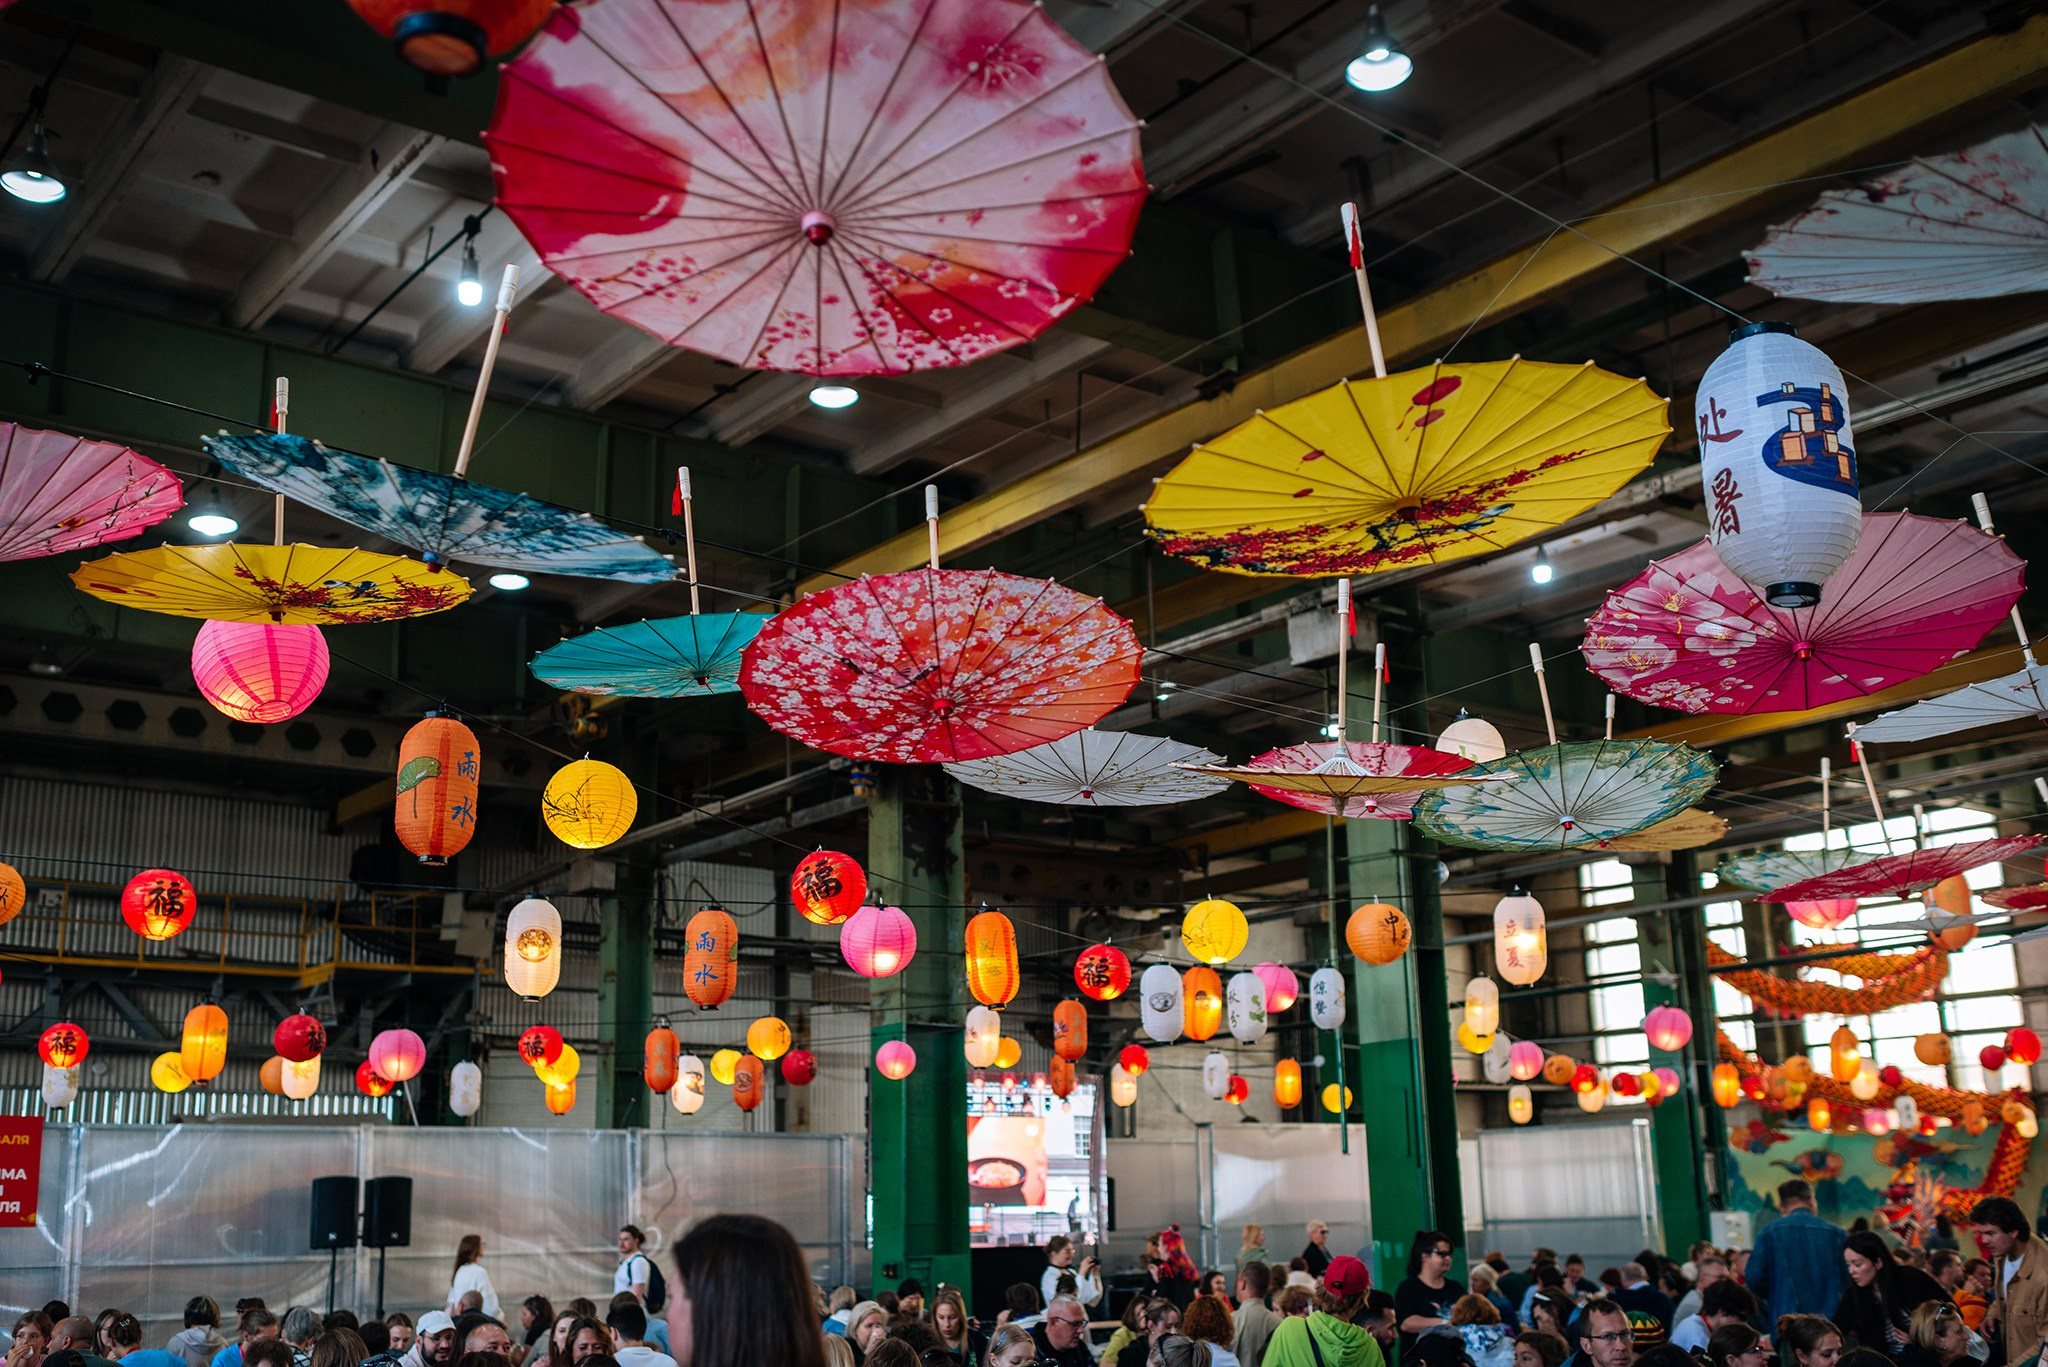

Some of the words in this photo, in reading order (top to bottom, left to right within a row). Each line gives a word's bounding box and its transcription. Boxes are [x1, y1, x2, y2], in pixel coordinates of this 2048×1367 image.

[1699, 397, 1743, 545] 处暑
[452, 751, 478, 828] 雨水
[146, 880, 184, 918] 福
[801, 860, 843, 902] 福
[695, 931, 719, 986] 雨水
[1503, 918, 1525, 968] 立夏
[1082, 957, 1110, 988] 福
[49, 1031, 76, 1056] 福
[522, 1035, 545, 1057] 福
[0, 1168, 28, 1180] МА
